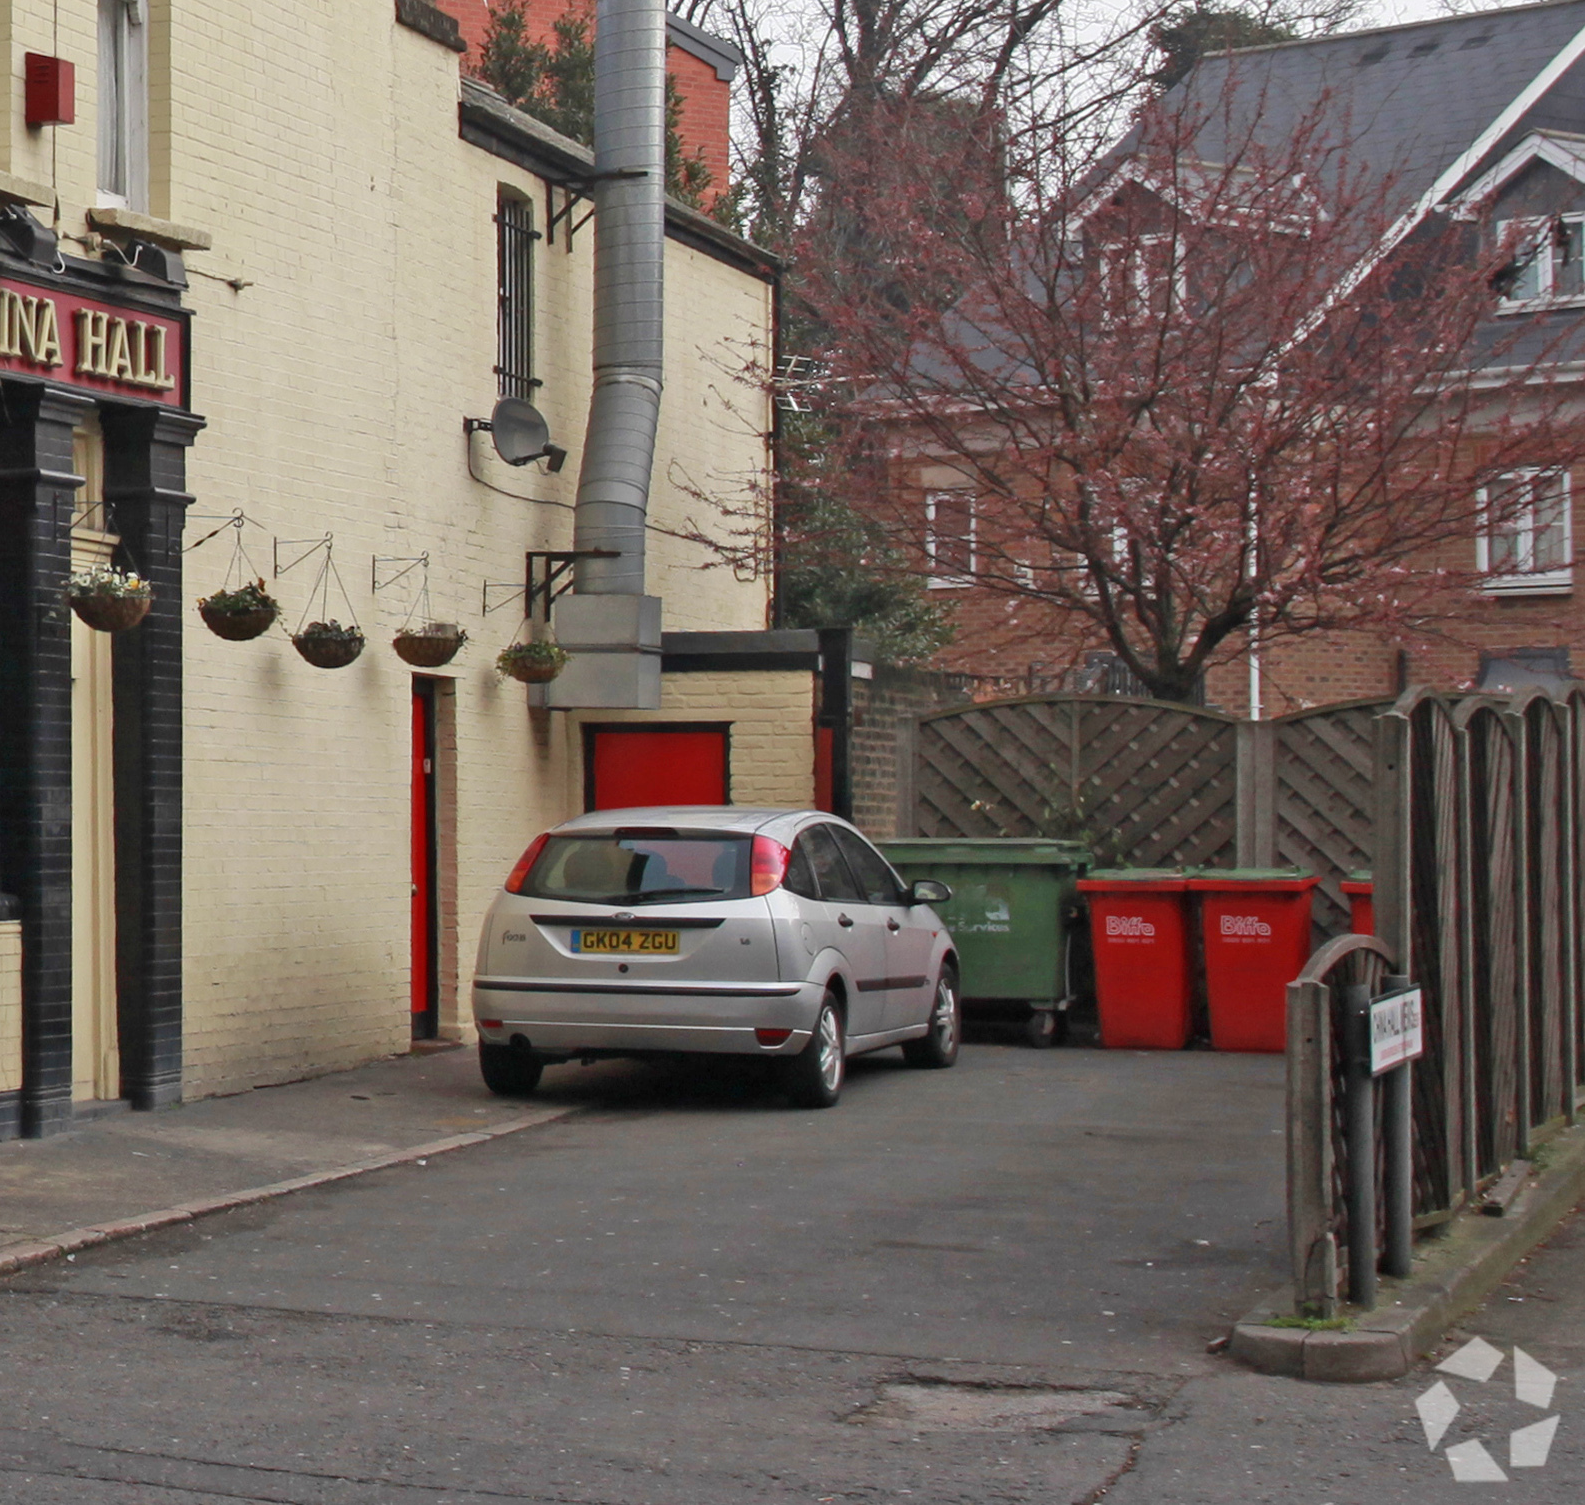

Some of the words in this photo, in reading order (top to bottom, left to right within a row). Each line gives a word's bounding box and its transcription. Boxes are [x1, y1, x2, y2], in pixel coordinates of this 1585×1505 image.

[75, 307, 175, 391] HALL
[1106, 916, 1155, 936] Biffa
[1221, 915, 1271, 936] Biffa
[583, 932, 632, 950] GK04
[640, 933, 677, 950] ZGU
